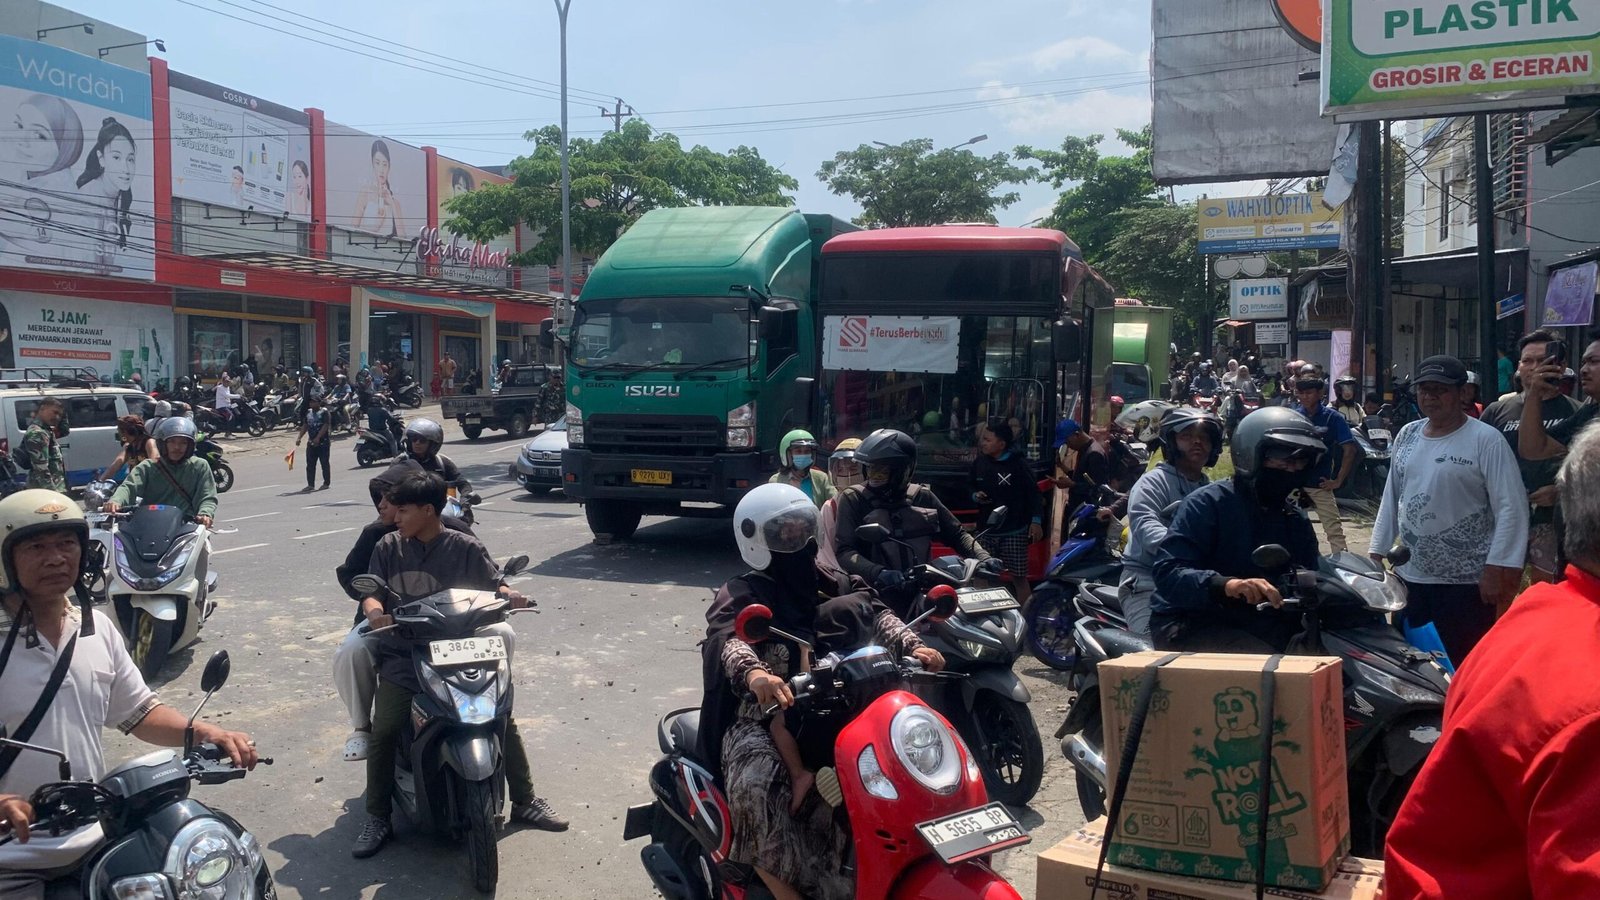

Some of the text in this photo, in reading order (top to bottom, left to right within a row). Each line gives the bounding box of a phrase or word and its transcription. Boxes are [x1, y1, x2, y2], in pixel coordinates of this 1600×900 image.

[1384, 0, 1579, 39] PLASTIK
[1373, 54, 1588, 89] GROSIR & ECERAN
[16, 54, 123, 104] Wardah
[223, 91, 248, 105] COSRX
[1226, 194, 1314, 218] WAHYU OPTIK
[416, 226, 470, 261] Elisha
[1241, 286, 1281, 296] OPTIK
[41, 308, 88, 324] 12 JAM
[28, 324, 103, 336] MEREDAKAN JERAWAT
[18, 334, 70, 344] MENYAMARKAN
[72, 336, 92, 345] BEKAS
[625, 385, 680, 396] ISUZU
[1450, 456, 1473, 465] Avian
[433, 639, 502, 653] H 3849 PJ
[1349, 705, 1373, 717] HONDA
[152, 768, 179, 780] HONDA
[928, 810, 1004, 843] H 5655 BP
[1124, 813, 1170, 835] 6 BOX
